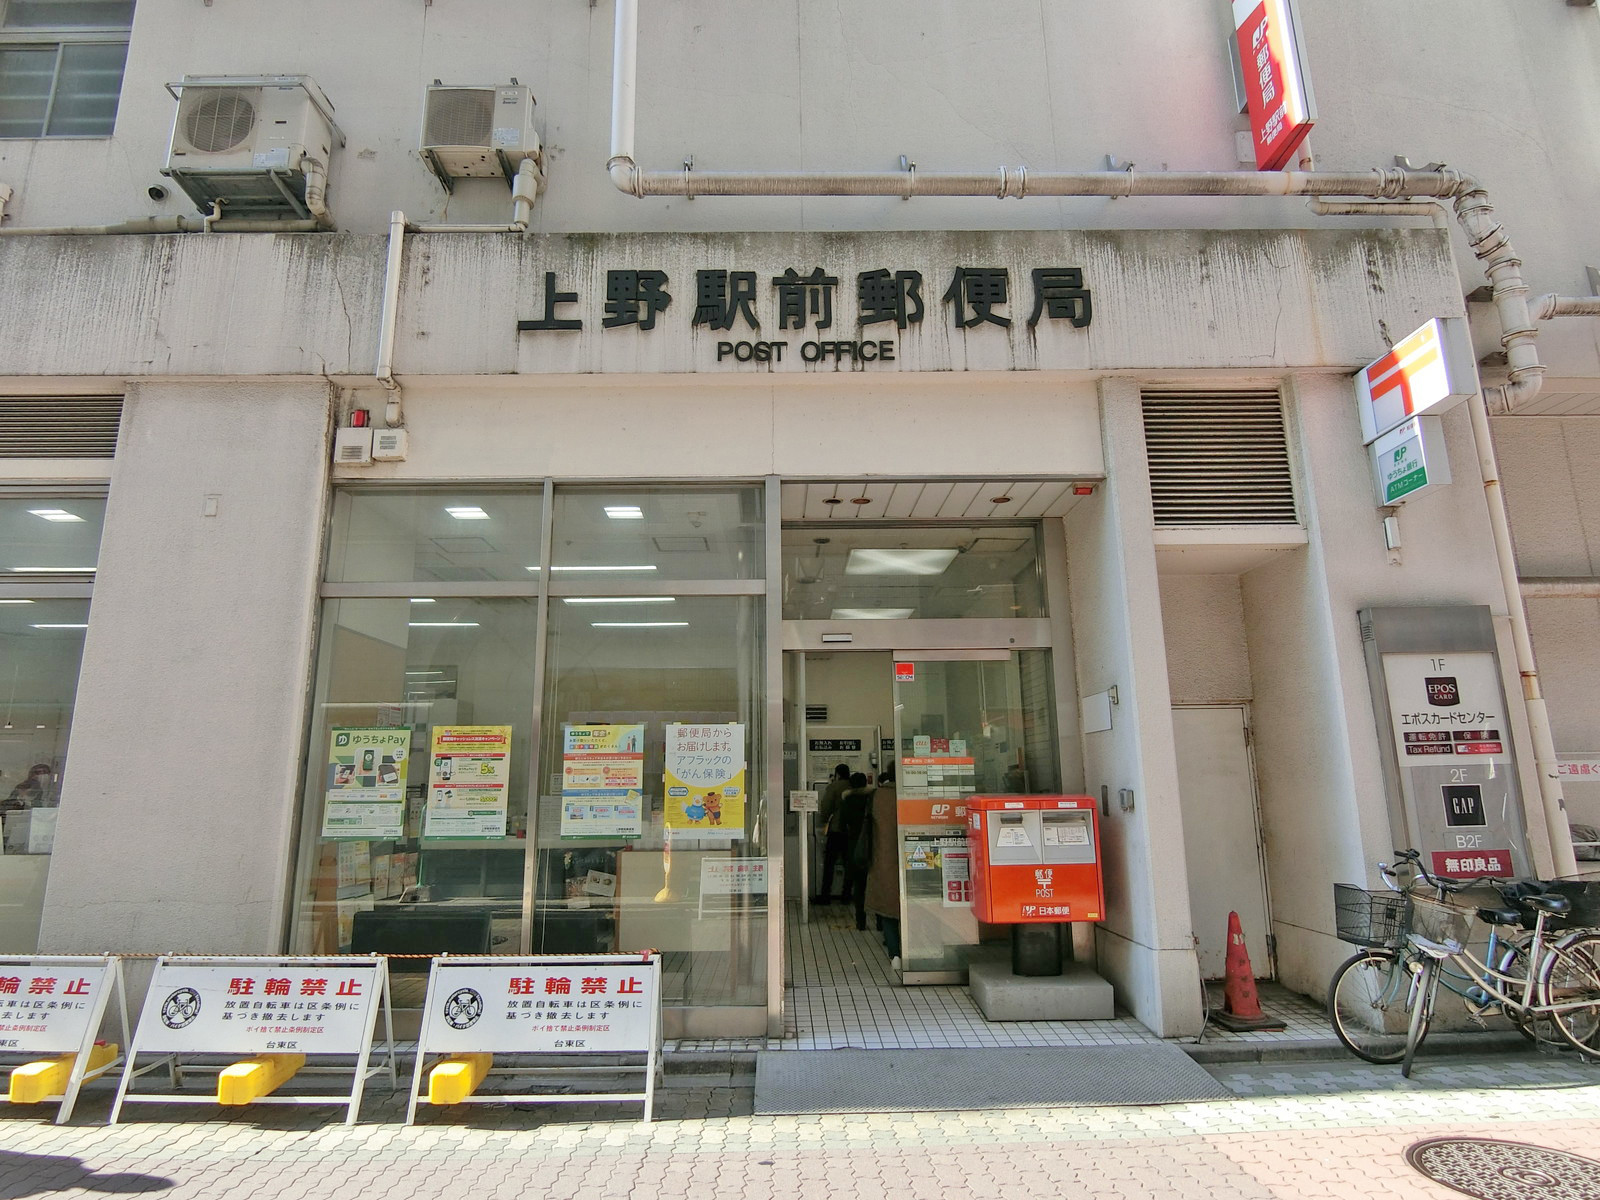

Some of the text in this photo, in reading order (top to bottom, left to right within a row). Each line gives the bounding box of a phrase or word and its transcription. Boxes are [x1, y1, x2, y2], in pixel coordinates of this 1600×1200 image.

[1256, 43, 1276, 110] 郵便局
[517, 266, 1093, 331] 上野駅前郵便局
[718, 340, 895, 362] POST OFFICE
[1387, 459, 1418, 480] ゆうちょ銀行
[1390, 473, 1424, 493] ATMコーナー
[1430, 659, 1446, 672] 1F
[1428, 683, 1456, 695] EPOS
[1401, 711, 1496, 725] エポスカードセンター
[677, 727, 732, 739] 郵便局から
[1408, 732, 1447, 741] 運転免許
[352, 735, 406, 747] ゆうちょPay
[677, 741, 732, 752] お届けします。
[1408, 744, 1451, 754] Tax Refund
[677, 756, 732, 766] アフラックの
[676, 768, 732, 780] 「がん保険」
[1557, 763, 1600, 775] ご遠慮く
[1450, 769, 1468, 782] 2F
[1452, 797, 1474, 815] GAP
[1456, 835, 1482, 848] B2F
[1445, 856, 1502, 873] 無印良品
[1034, 868, 1053, 880] 郵便
[1035, 888, 1054, 898] POST
[1039, 906, 1070, 916] 日本郵便
[0, 976, 91, 995] 輪禁止
[227, 977, 364, 996] 駐輪禁止
[508, 976, 643, 995] 駐輪禁止
[224, 1000, 360, 1011] 放置自転車は区条例に
[507, 1000, 642, 1009] 放置自転車は区条例に
[222, 1012, 326, 1022] 基づき撤去します
[506, 1011, 610, 1020] 基づき撤去します
[246, 1025, 324, 1034] ポイ捨て禁止条例制定区
[266, 1041, 298, 1049] 台東区
[554, 1039, 585, 1048] 台東区
